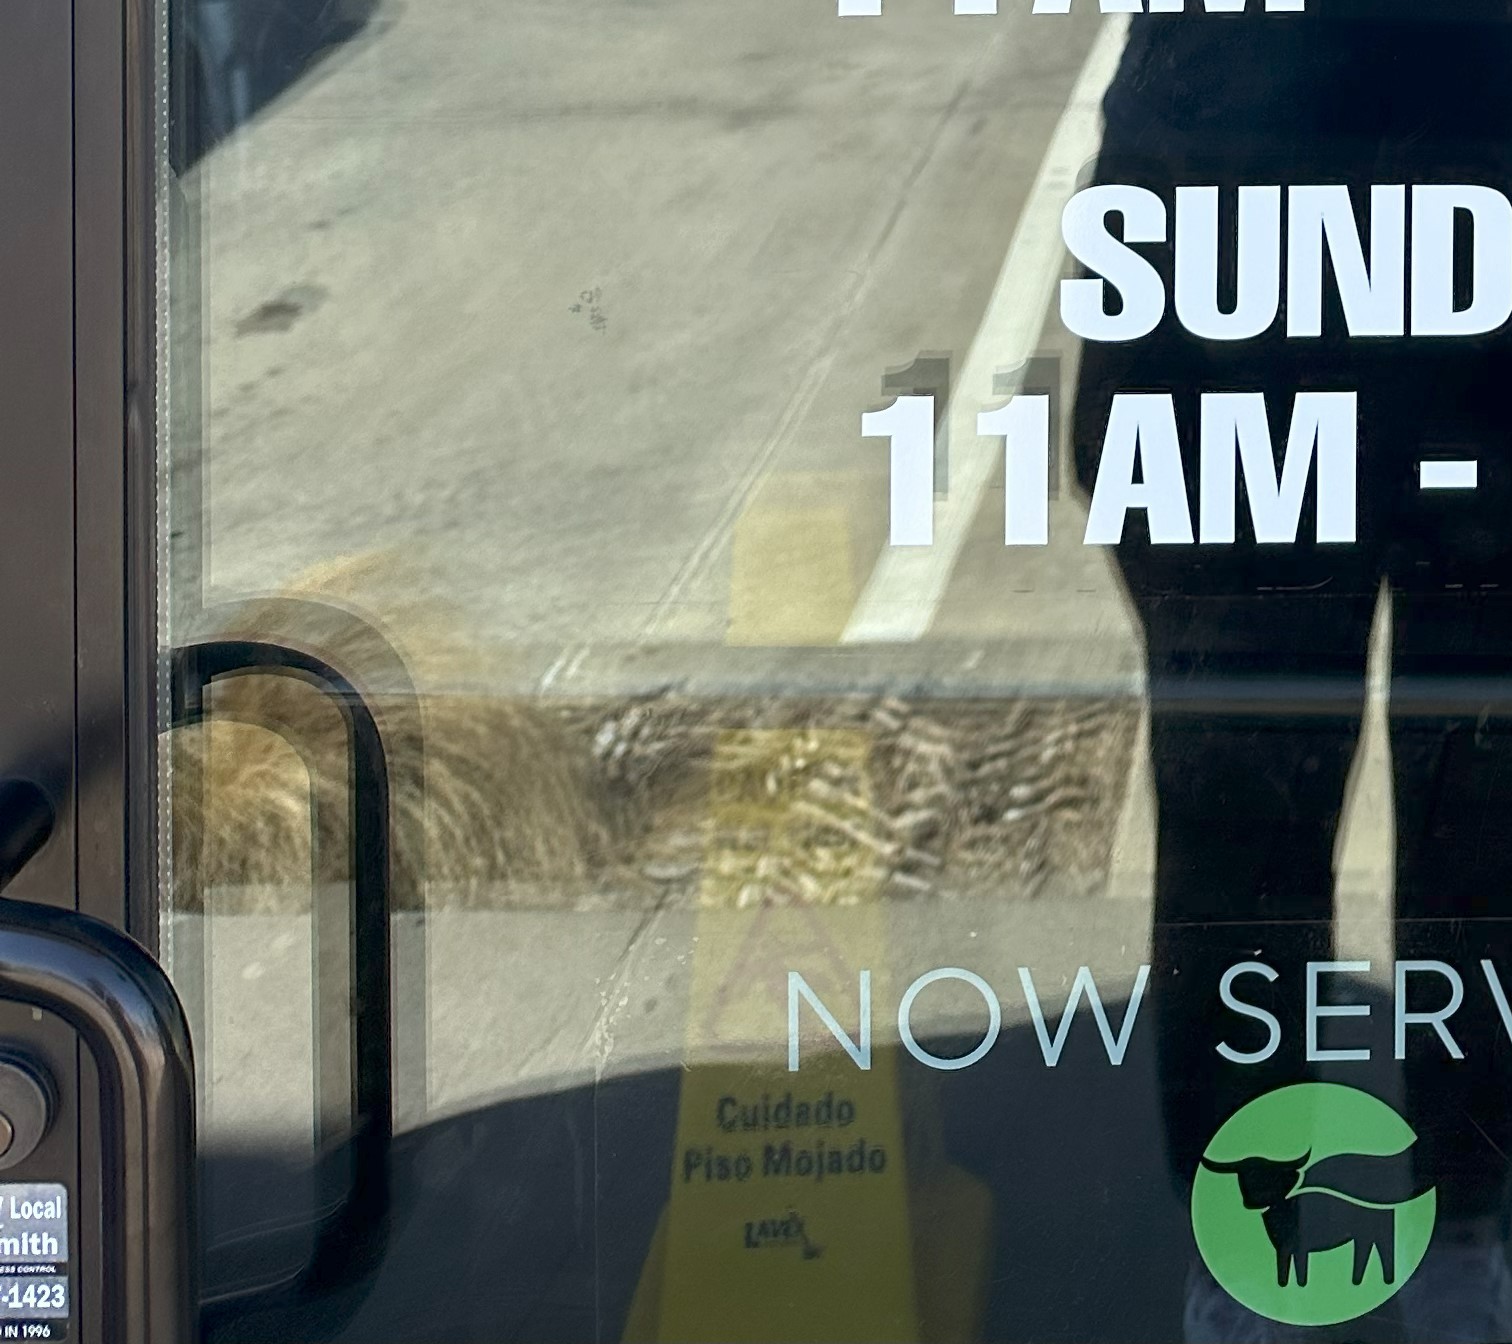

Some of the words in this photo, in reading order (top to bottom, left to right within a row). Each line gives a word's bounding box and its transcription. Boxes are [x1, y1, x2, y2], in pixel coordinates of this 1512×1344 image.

[861, 392, 1358, 546] 11AM
[786, 964, 1151, 1072] NOW
[716, 1091, 855, 1132] Cuidado
[683, 1145, 752, 1183] Piso
[763, 1136, 886, 1183] Mojado
[10, 1195, 62, 1220] Local
[4, 1324, 19, 1339] IN
[22, 1324, 52, 1339] 1996
